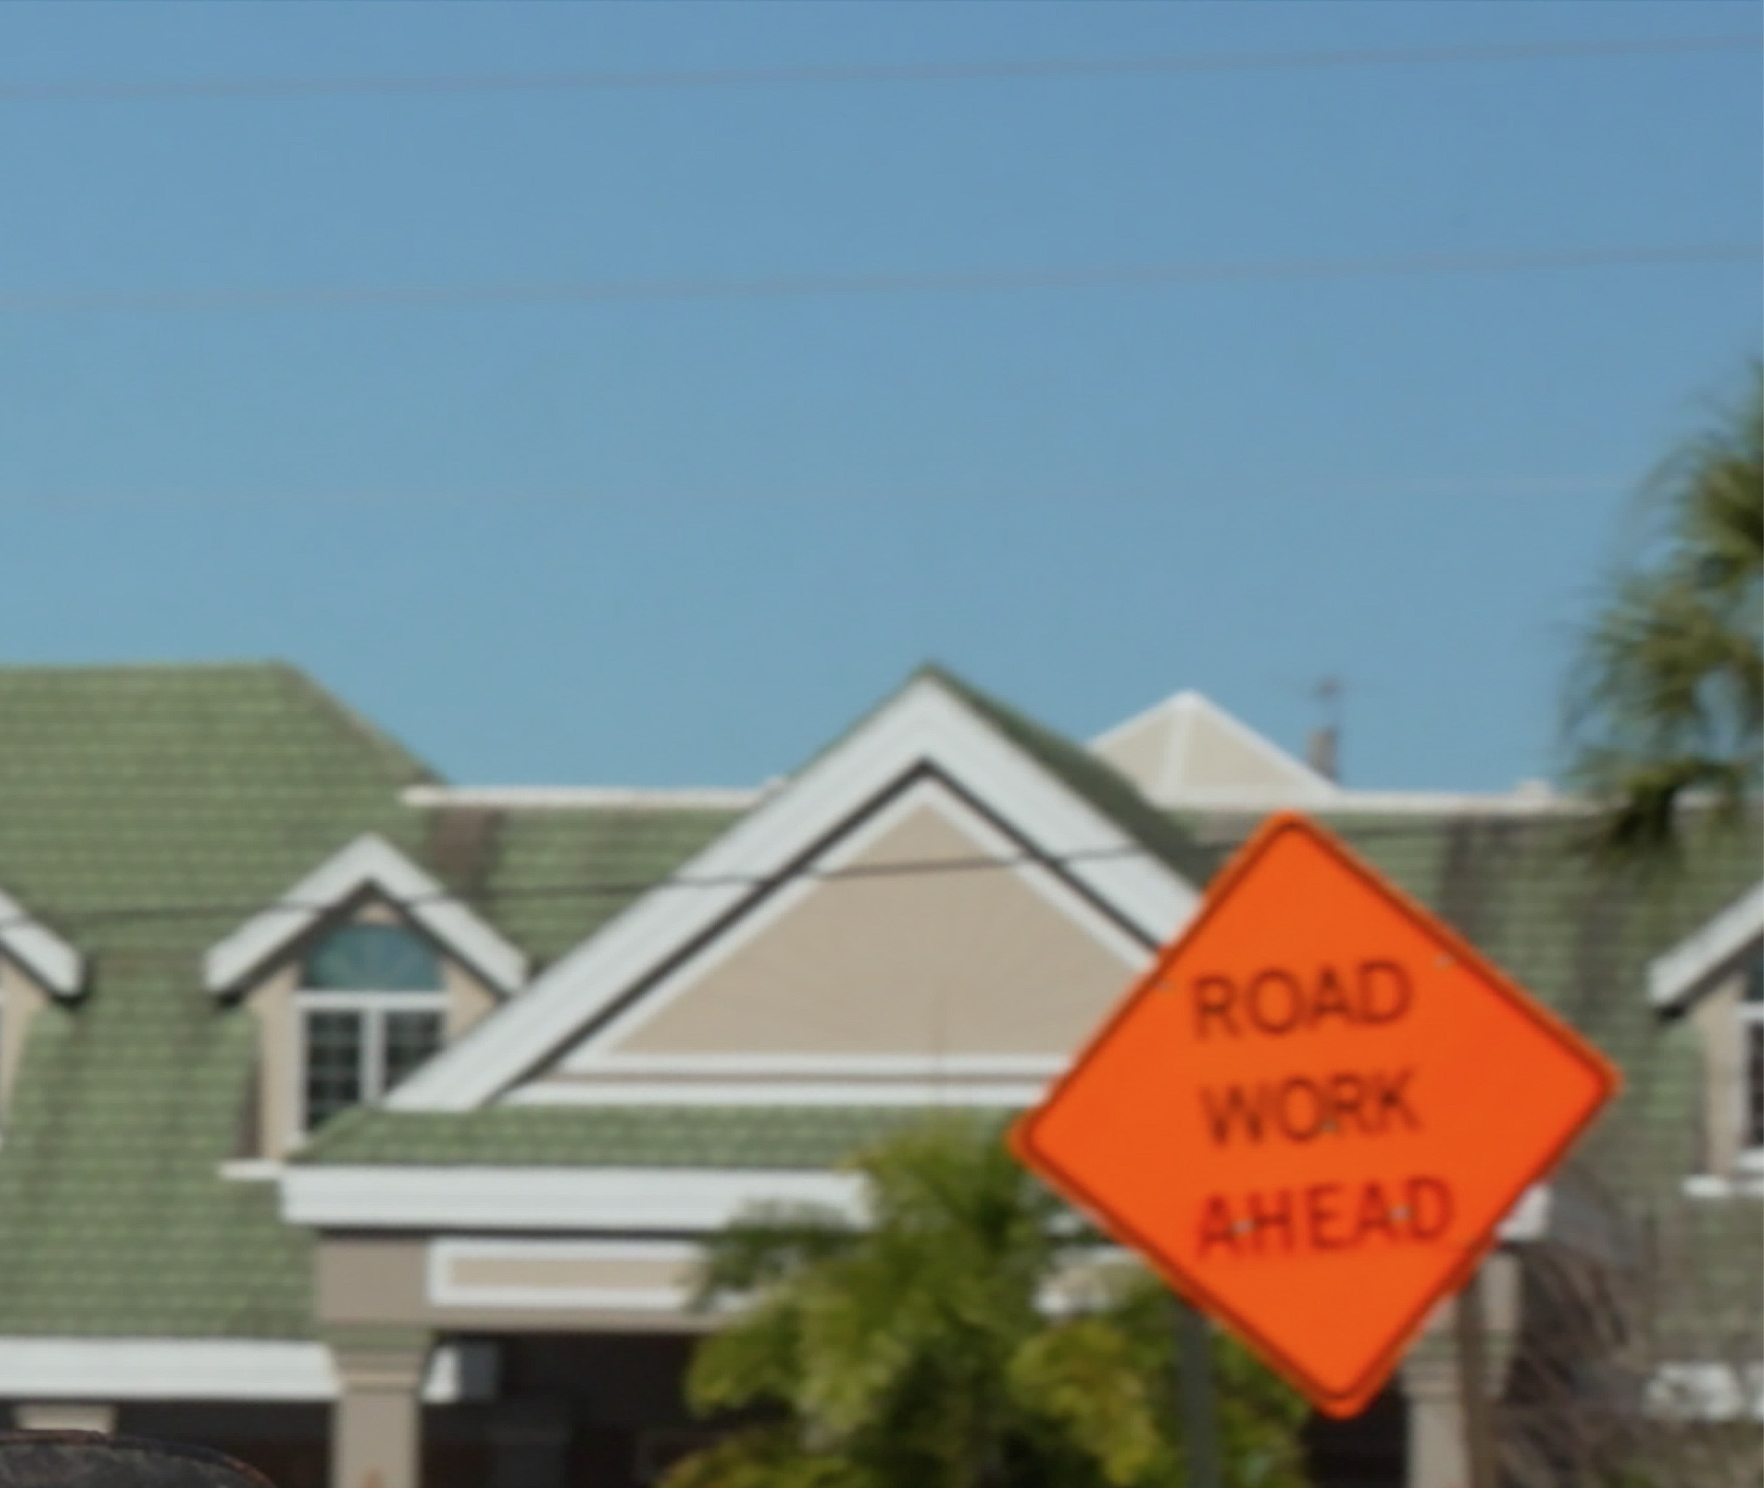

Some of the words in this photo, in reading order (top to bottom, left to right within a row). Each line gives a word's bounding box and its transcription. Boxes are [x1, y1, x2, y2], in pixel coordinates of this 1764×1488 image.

[1191, 959, 1412, 1038] ROAD
[1199, 1067, 1422, 1147] WORK
[1196, 1174, 1454, 1259] AHEAD
